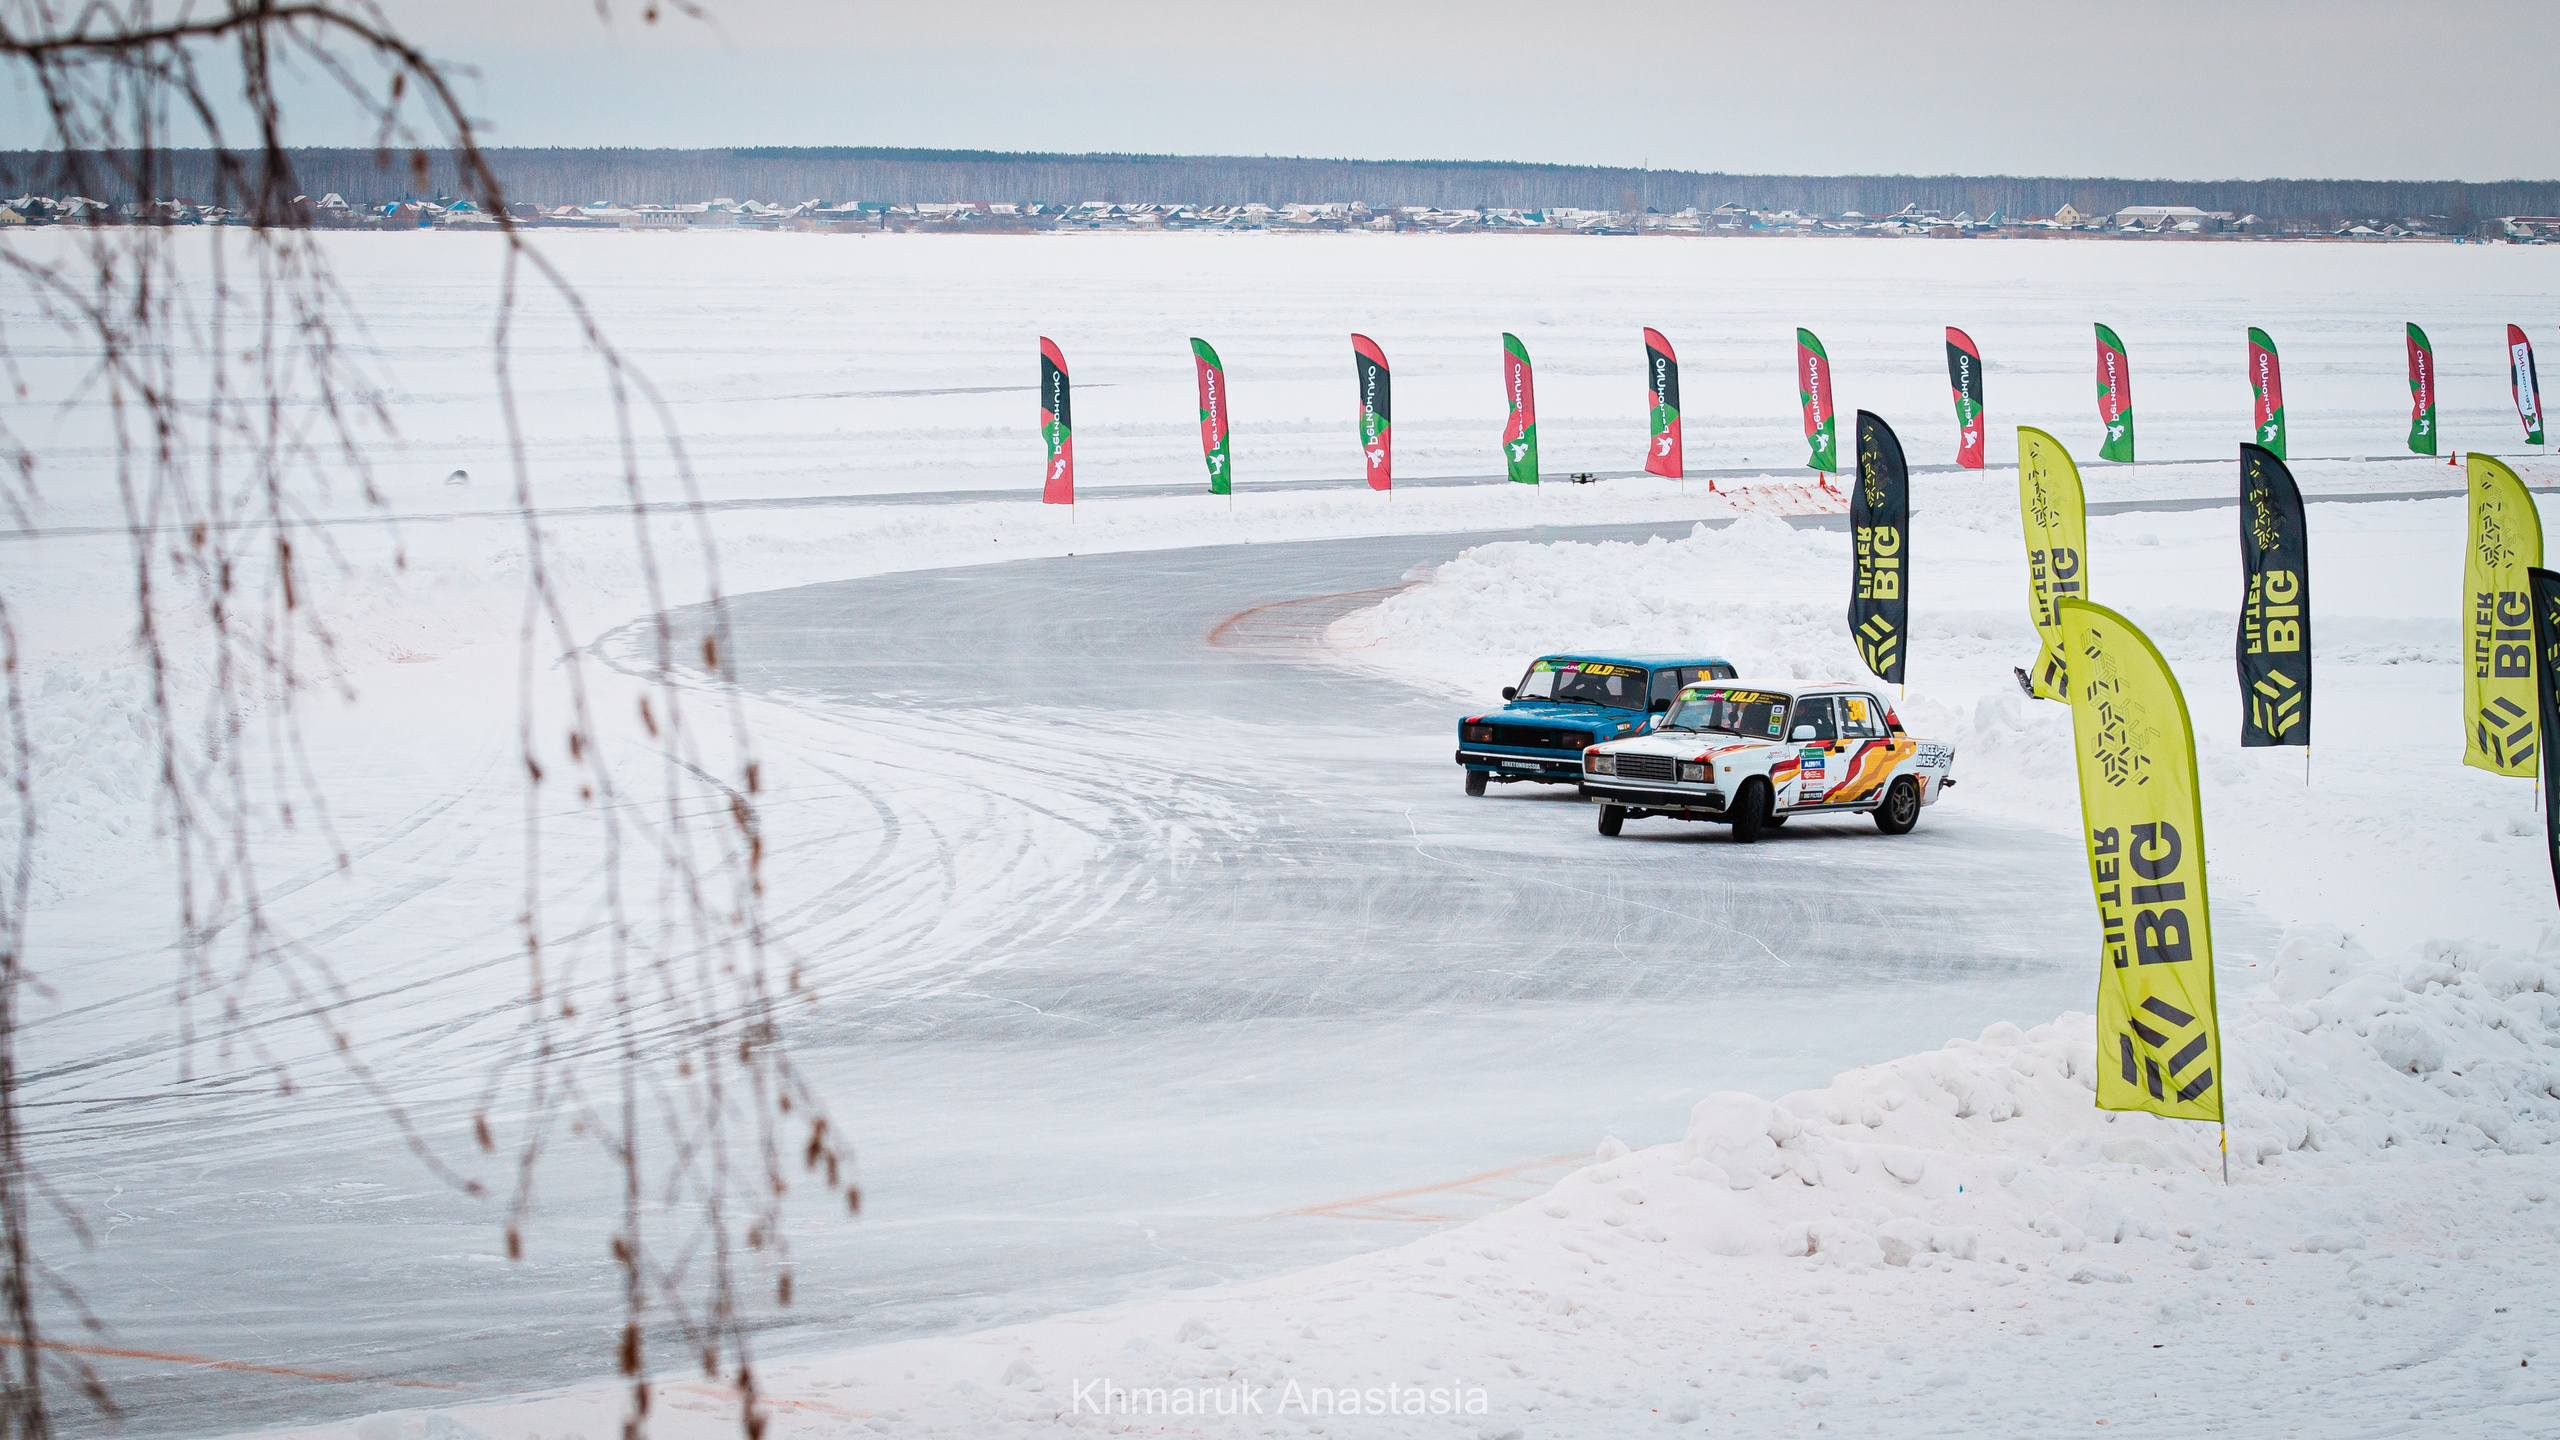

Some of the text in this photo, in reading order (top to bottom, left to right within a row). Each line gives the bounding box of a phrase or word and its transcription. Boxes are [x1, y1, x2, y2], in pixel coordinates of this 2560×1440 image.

[1585, 664, 1615, 676] ULD
[1730, 691, 1760, 703] ULD
[1847, 699, 1866, 721] 30
[1918, 745, 1935, 755] RACE
[1916, 755, 1935, 767] BASE
